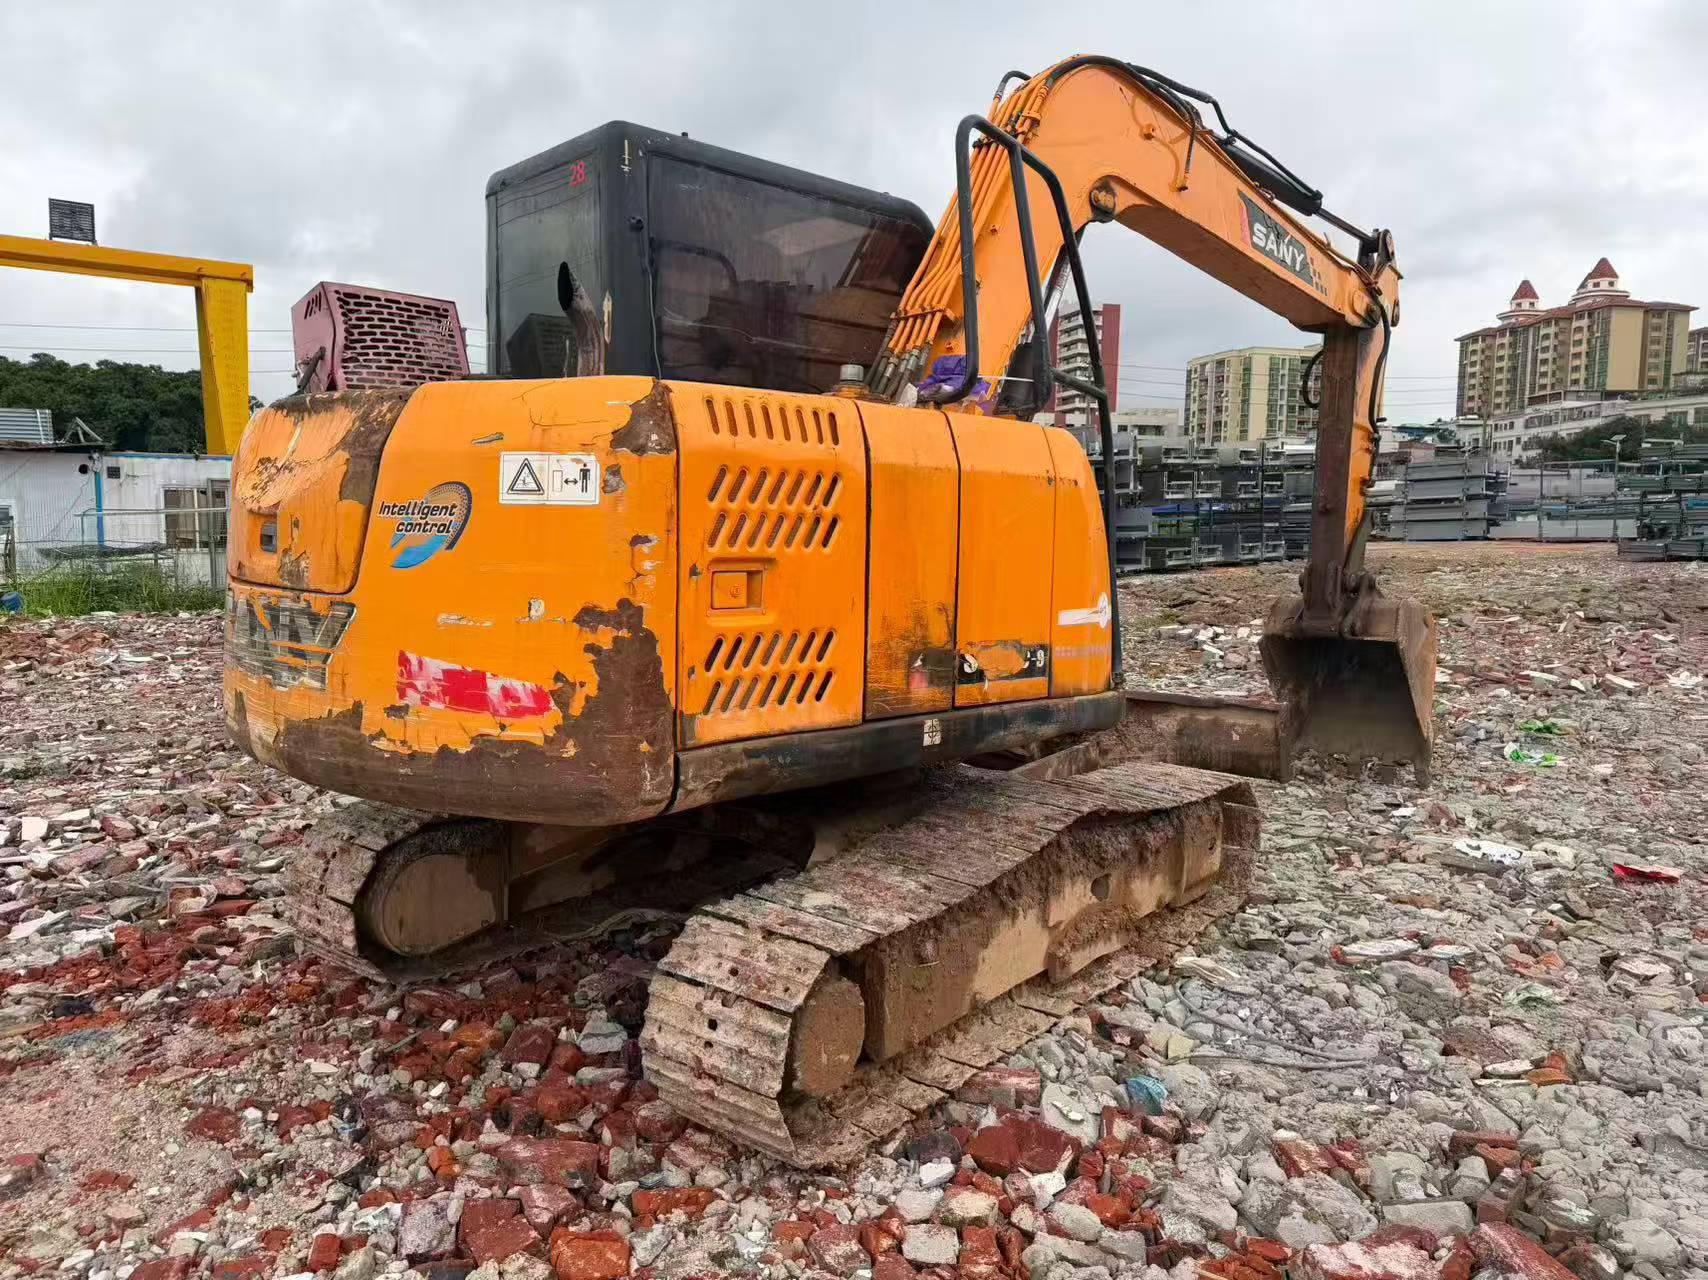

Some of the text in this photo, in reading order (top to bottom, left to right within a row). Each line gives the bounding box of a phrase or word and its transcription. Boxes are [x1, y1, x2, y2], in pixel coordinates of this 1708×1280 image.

[1252, 222, 1305, 272] SANY
[379, 500, 458, 520] Intelligent
[395, 519, 453, 534] control
